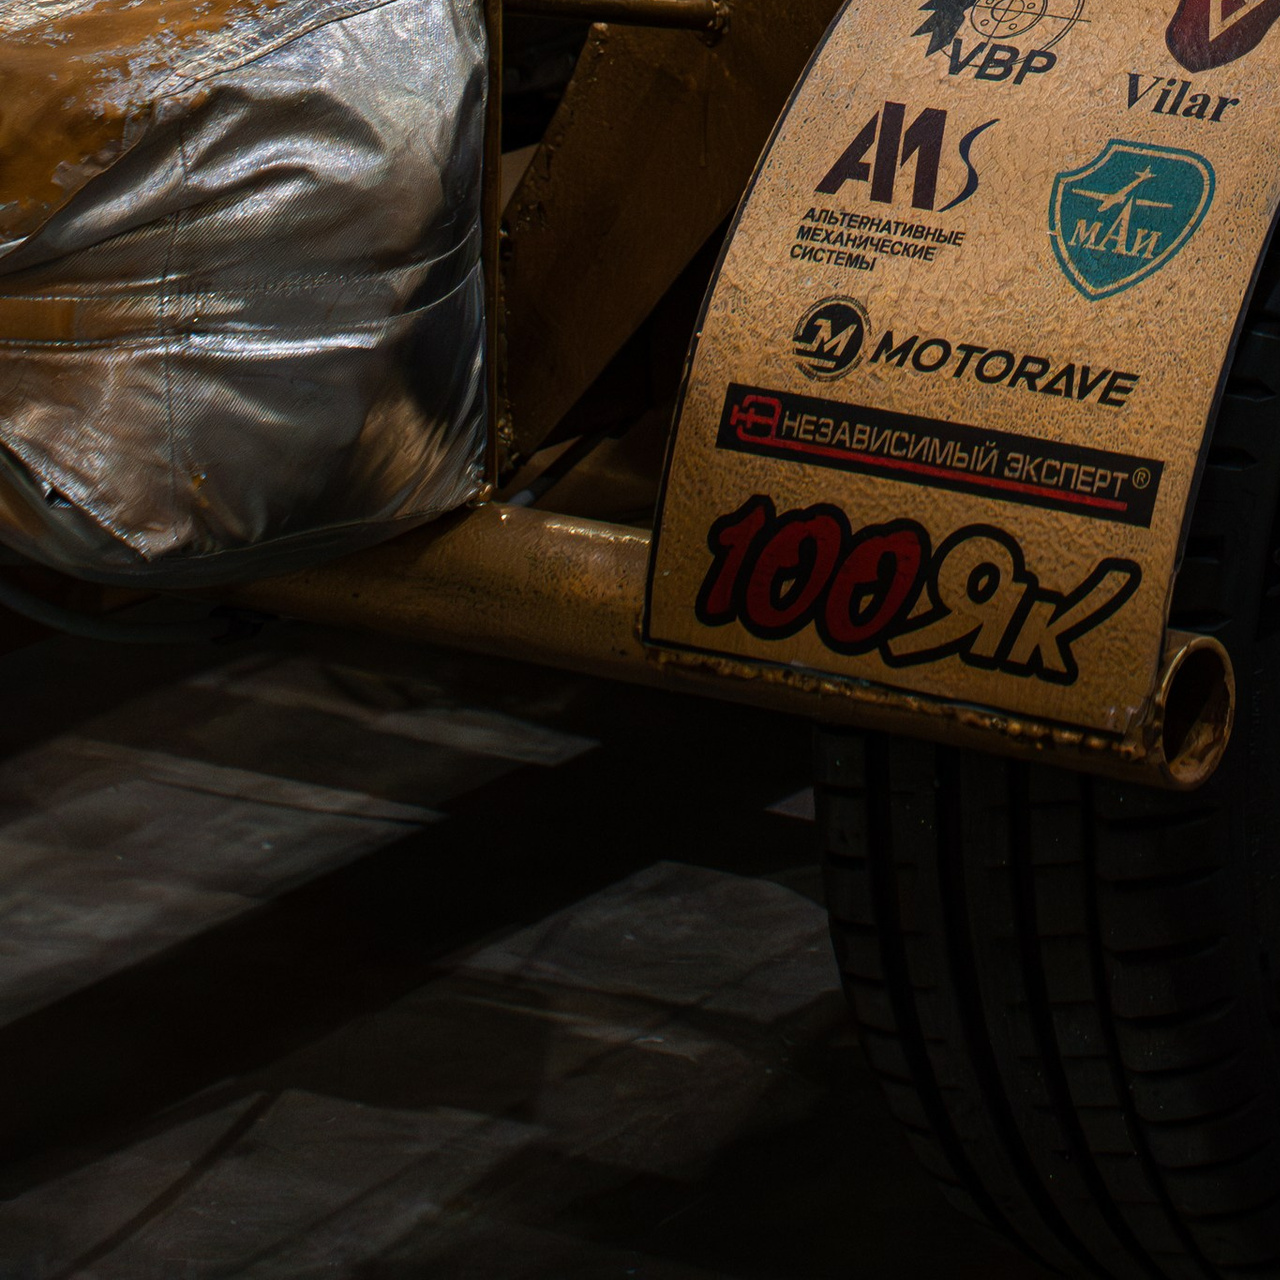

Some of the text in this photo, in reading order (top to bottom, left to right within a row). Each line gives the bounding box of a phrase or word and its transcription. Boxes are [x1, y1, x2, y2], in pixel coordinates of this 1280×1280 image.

[948, 37, 1058, 85] VBP
[1126, 72, 1240, 124] Vilar
[795, 225, 938, 262] МЕХАНИЧЕСКИЕ
[802, 207, 966, 247] АЛЬТЕРНАТИВНЫЕ
[789, 243, 878, 272] СИСТЕМЫ
[870, 330, 1141, 407] MOTORAVE
[781, 409, 1000, 476] НЕЗАВИСИМЫЙ
